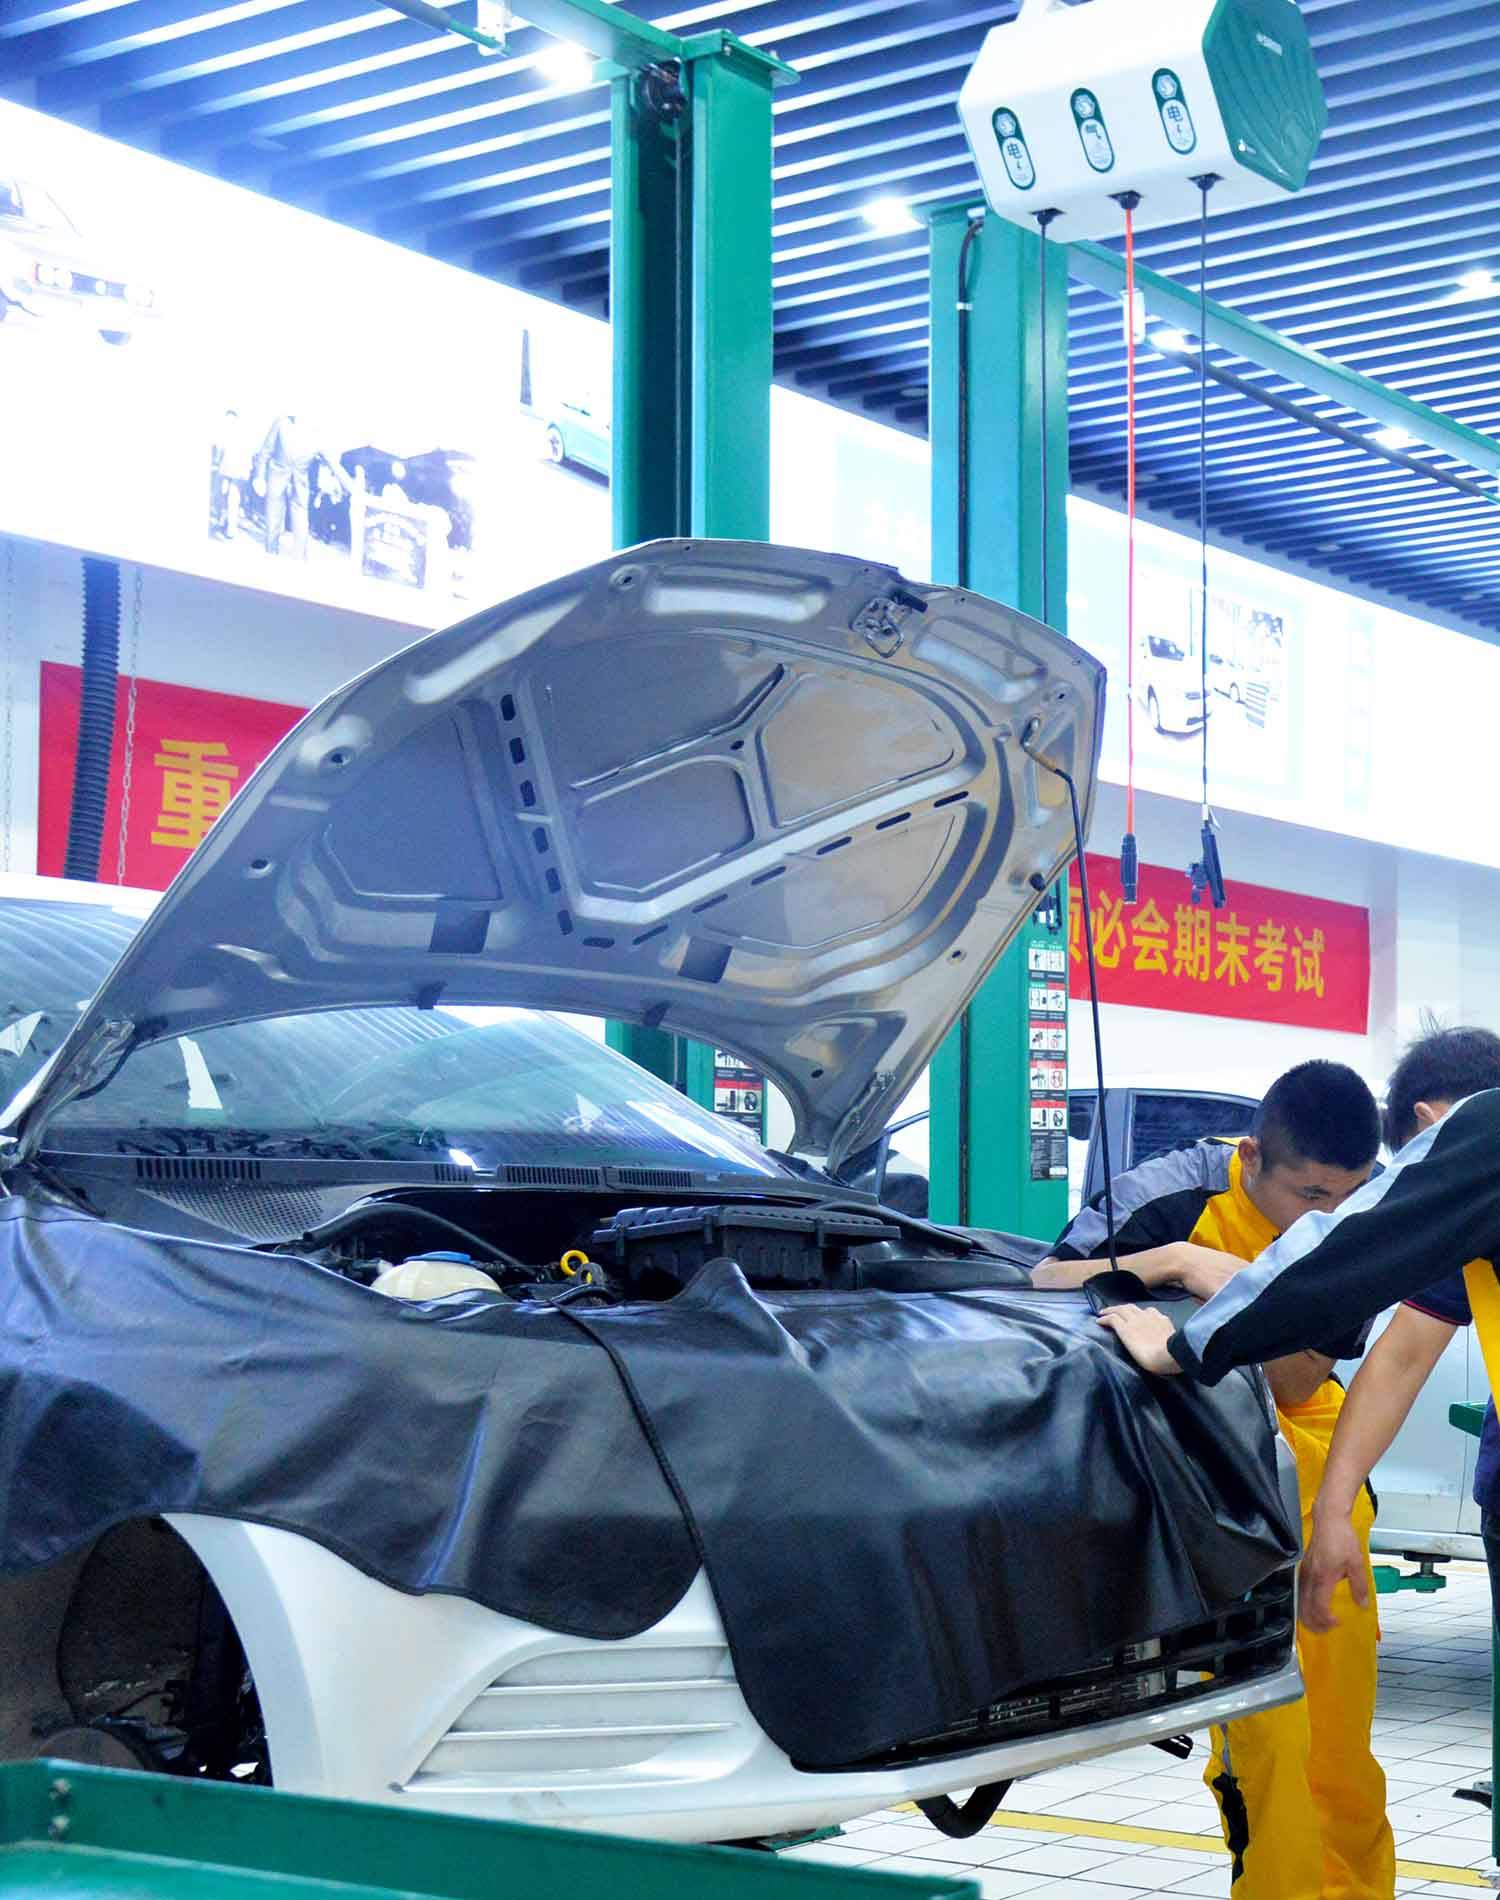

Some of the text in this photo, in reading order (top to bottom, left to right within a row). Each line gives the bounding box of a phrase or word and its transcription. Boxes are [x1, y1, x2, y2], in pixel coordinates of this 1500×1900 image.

[1167, 105, 1184, 122] 电
[1007, 143, 1023, 159] 电
[151, 739, 239, 848] 重
